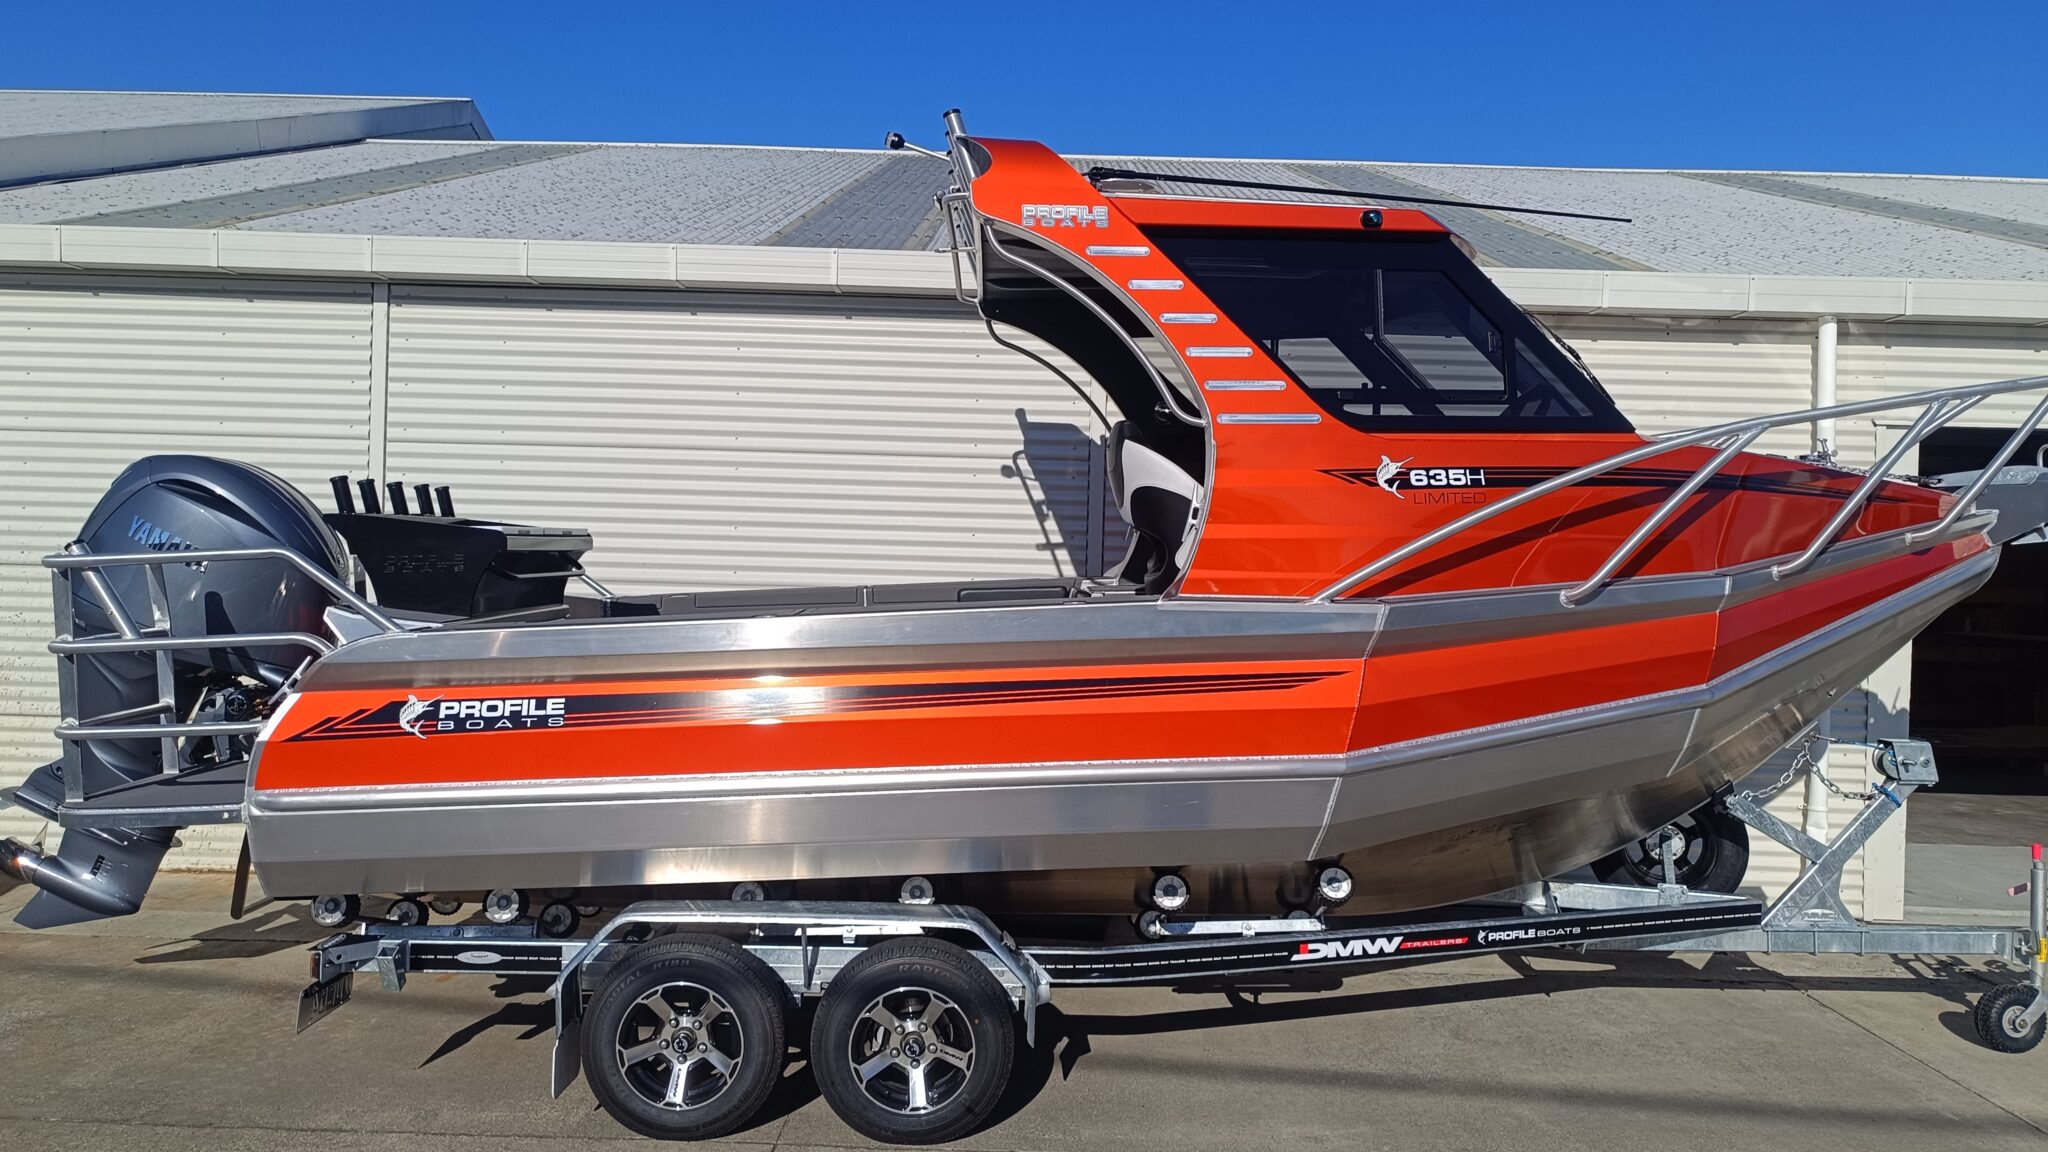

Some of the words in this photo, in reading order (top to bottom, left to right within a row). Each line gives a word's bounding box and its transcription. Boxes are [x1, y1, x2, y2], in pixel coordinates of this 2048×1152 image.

[1022, 204, 1109, 219] PROFILE
[1022, 218, 1109, 228] BOATS
[1409, 468, 1486, 486] 635H
[1413, 491, 1487, 505] LIMITED
[438, 697, 566, 719] PROFILE
[437, 717, 565, 731] BOATS
[1290, 936, 1404, 961] DMW
[1405, 937, 1464, 948] TRAILERS
[1487, 928, 1536, 942] PROFILE
[1536, 927, 1581, 937] BOATS
